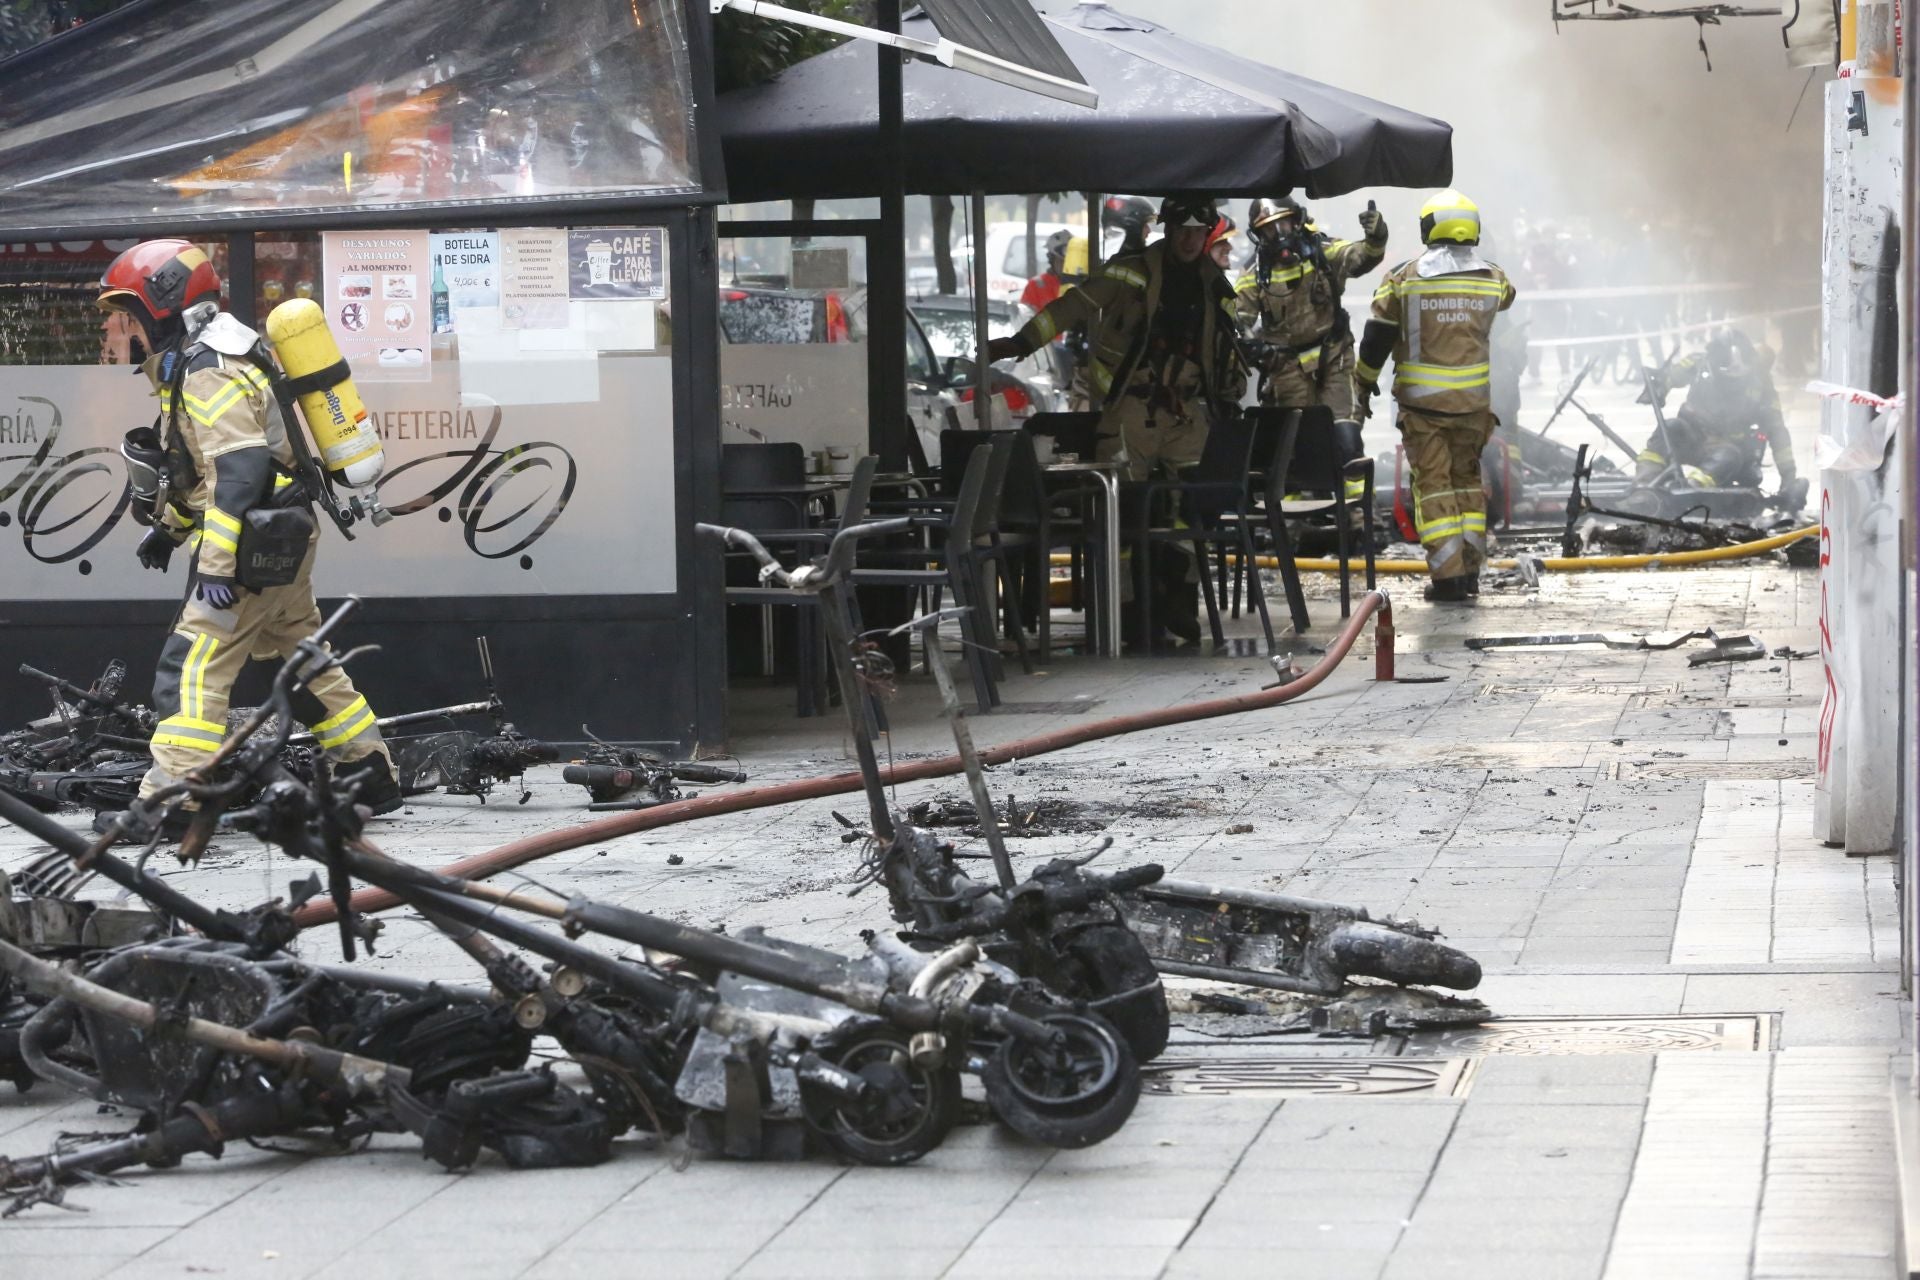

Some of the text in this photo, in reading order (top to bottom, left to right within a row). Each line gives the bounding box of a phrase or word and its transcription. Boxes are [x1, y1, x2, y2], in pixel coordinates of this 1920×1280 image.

[342, 239, 412, 248] DESAYUNOS
[444, 239, 489, 250] BOTELLA
[612, 233, 652, 255] CAFÉ
[347, 252, 407, 260] VARIADOS
[444, 254, 491, 265] DE SIDRA
[361, 264, 407, 272] MOMENTO
[624, 256, 652, 270] PARA
[484, 278, 491, 286] €
[612, 269, 652, 282] LLEVAR
[1421, 298, 1484, 311] BOMBEROS
[325, 390, 346, 427] Dräge
[0, 407, 38, 444] RÍA
[371, 402, 478, 441] AFETERÍA
[252, 552, 297, 571] Dräger
